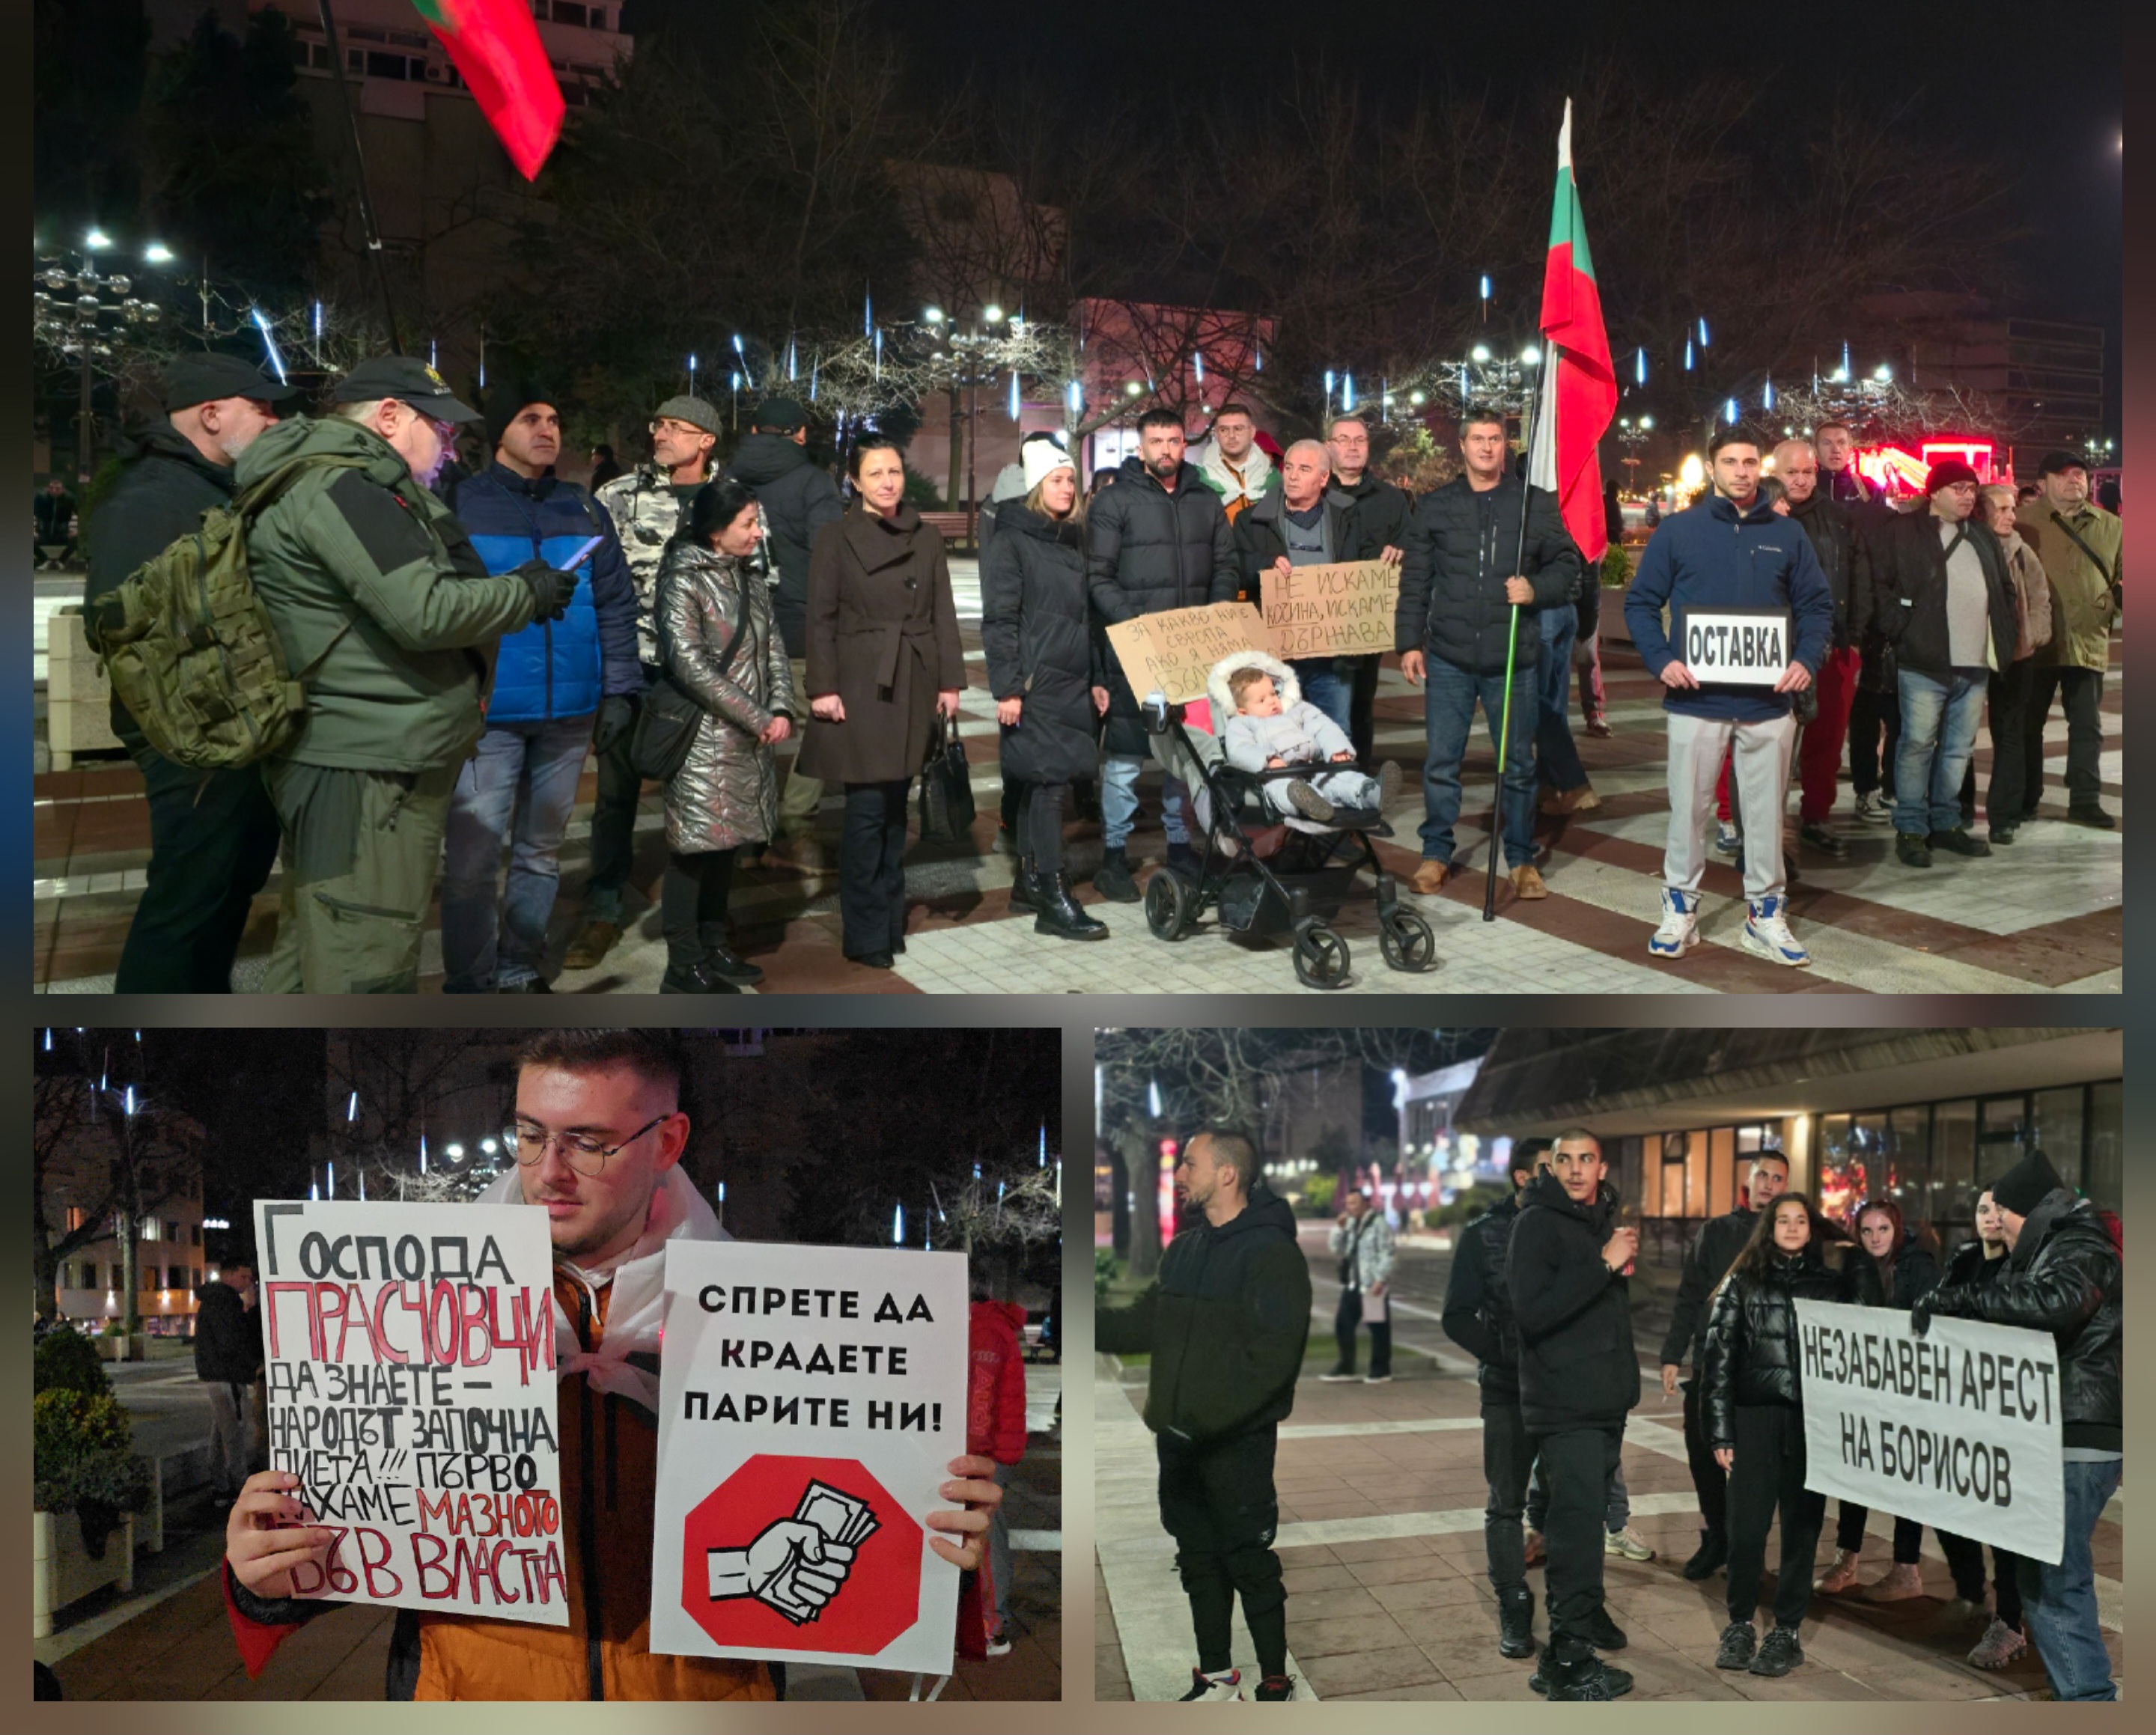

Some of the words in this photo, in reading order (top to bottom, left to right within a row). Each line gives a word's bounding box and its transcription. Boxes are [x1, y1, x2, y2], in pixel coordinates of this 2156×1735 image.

[1275, 572, 1304, 598] НЕ
[1318, 567, 1398, 594] ИСКАМЕ
[1327, 594, 1393, 618] ИСКАМЕ
[1127, 622, 1151, 642] ЗА
[1157, 611, 1210, 633] КАКВО
[1166, 626, 1228, 648] ЕВРОПА
[1280, 620, 1392, 652] ДЪРЖАВА
[1688, 625, 1782, 667] ОСТАВКА
[1146, 652, 1179, 673] АКО
[1189, 647, 1201, 662] Я
[1207, 638, 1254, 658] НЯМА
[698, 1284, 859, 1319] СПРЕТЕ
[873, 1293, 934, 1324] ДА
[266, 1278, 555, 1386] ПРАСЧОВЦИ
[720, 1338, 907, 1376] КРАДЕТЕ
[1803, 1324, 1951, 1404] НЕЗАБАВЕН
[1959, 1348, 2054, 1424] АРЕСТ
[269, 1361, 319, 1403] ДА
[325, 1364, 454, 1406] ЗНАЕТЕ
[270, 1406, 404, 1454] НАРОДЪТ
[412, 1406, 559, 1454] ЗАПОЧНА
[684, 1391, 849, 1427] ПАРИТЕ
[867, 1400, 942, 1433] НИ!
[416, 1452, 538, 1492] ПЪРВО
[1839, 1412, 1875, 1472] НА
[1879, 1420, 2012, 1507] БОРИСОВ
[276, 1484, 415, 1525] АХАМЕ
[415, 1488, 559, 1537] МАЗНОТО
